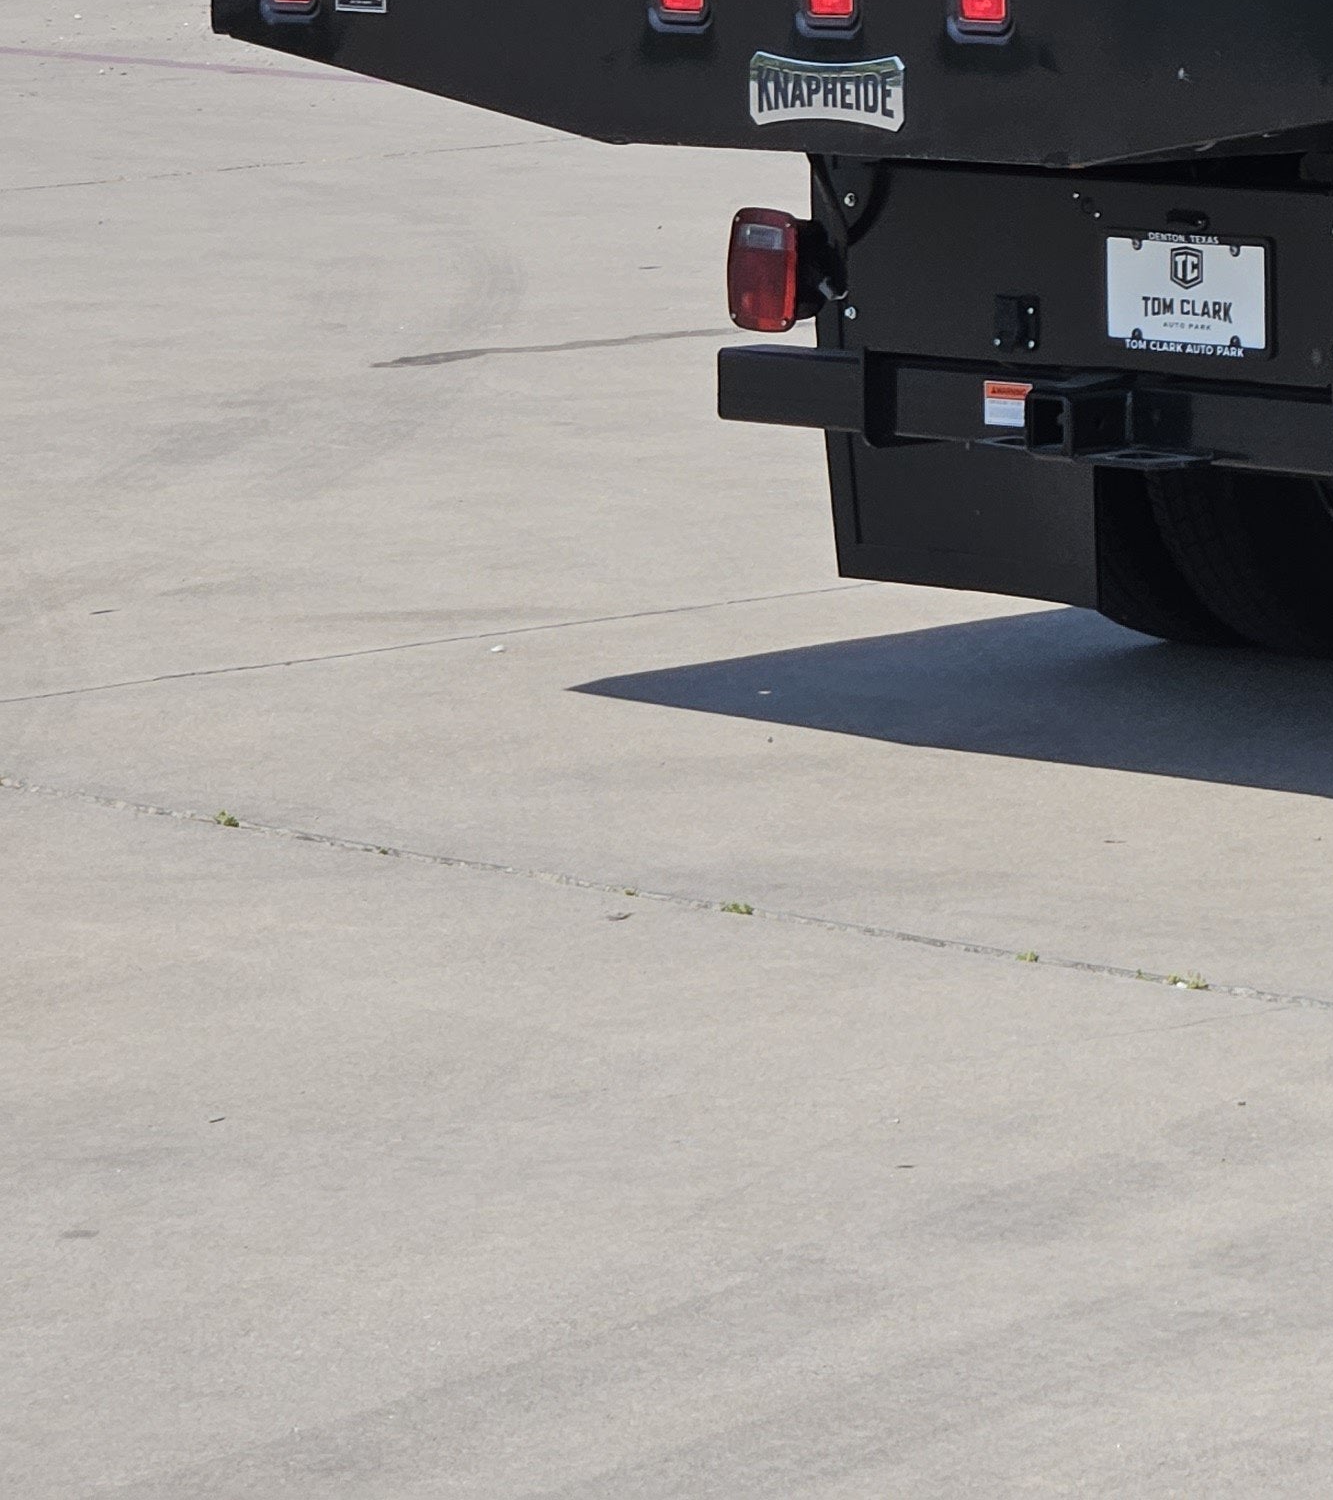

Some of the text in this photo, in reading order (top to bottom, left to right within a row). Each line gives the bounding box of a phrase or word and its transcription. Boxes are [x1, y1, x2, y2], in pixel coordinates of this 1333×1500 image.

[757, 65, 896, 119] KNAPHEIDE
[1190, 235, 1219, 245] TEXAS
[1174, 254, 1200, 281] TC
[1142, 296, 1232, 324] TOM CLARK
[1163, 322, 1211, 331] AUTO PARK
[1125, 339, 1244, 358] TOM CLARK AUTO PARK
